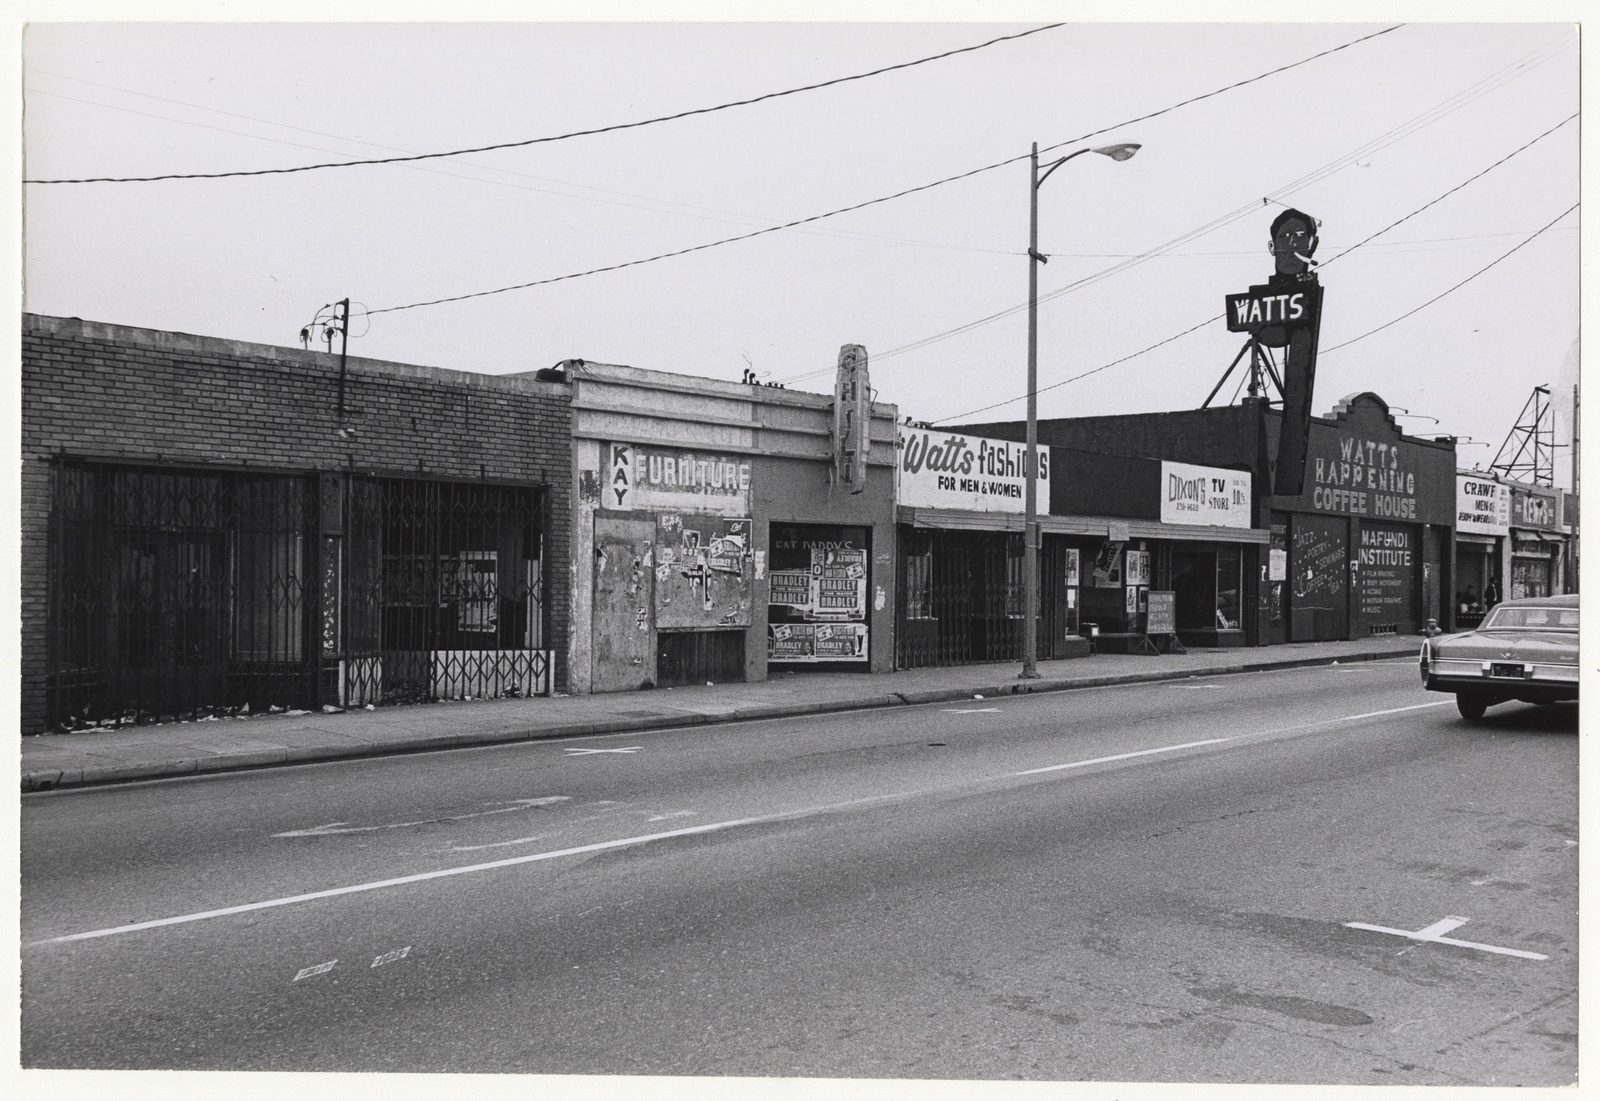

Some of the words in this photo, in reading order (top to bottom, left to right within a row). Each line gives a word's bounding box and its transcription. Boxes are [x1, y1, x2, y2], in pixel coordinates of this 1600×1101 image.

[1234, 293, 1304, 324] WATTS
[903, 433, 975, 475] Watts
[1339, 437, 1398, 470] WATTS
[613, 446, 629, 506] KAY
[1315, 458, 1415, 495] HAPPENING
[938, 476, 956, 491] FOR
[960, 478, 979, 493] MEN
[981, 481, 988, 495] &
[988, 482, 1022, 499] WOMEN
[1168, 472, 1206, 505] DIXON'S
[1212, 478, 1226, 493] TV
[1208, 496, 1229, 511] STORE
[1313, 486, 1367, 514] COFFEE
[1375, 494, 1416, 520] HOUSE
[776, 541, 798, 549] FAT
[1361, 529, 1408, 548] MAFUNDI
[1358, 548, 1411, 566] INSTITUTE
[772, 575, 808, 587] BRADLEY
[821, 580, 857, 590] BRADLEY
[771, 592, 807, 604] BRADLEY
[821, 597, 856, 608] BRADLEY
[775, 641, 802, 650] BRADLEY
[817, 641, 843, 649] BRADLEY
